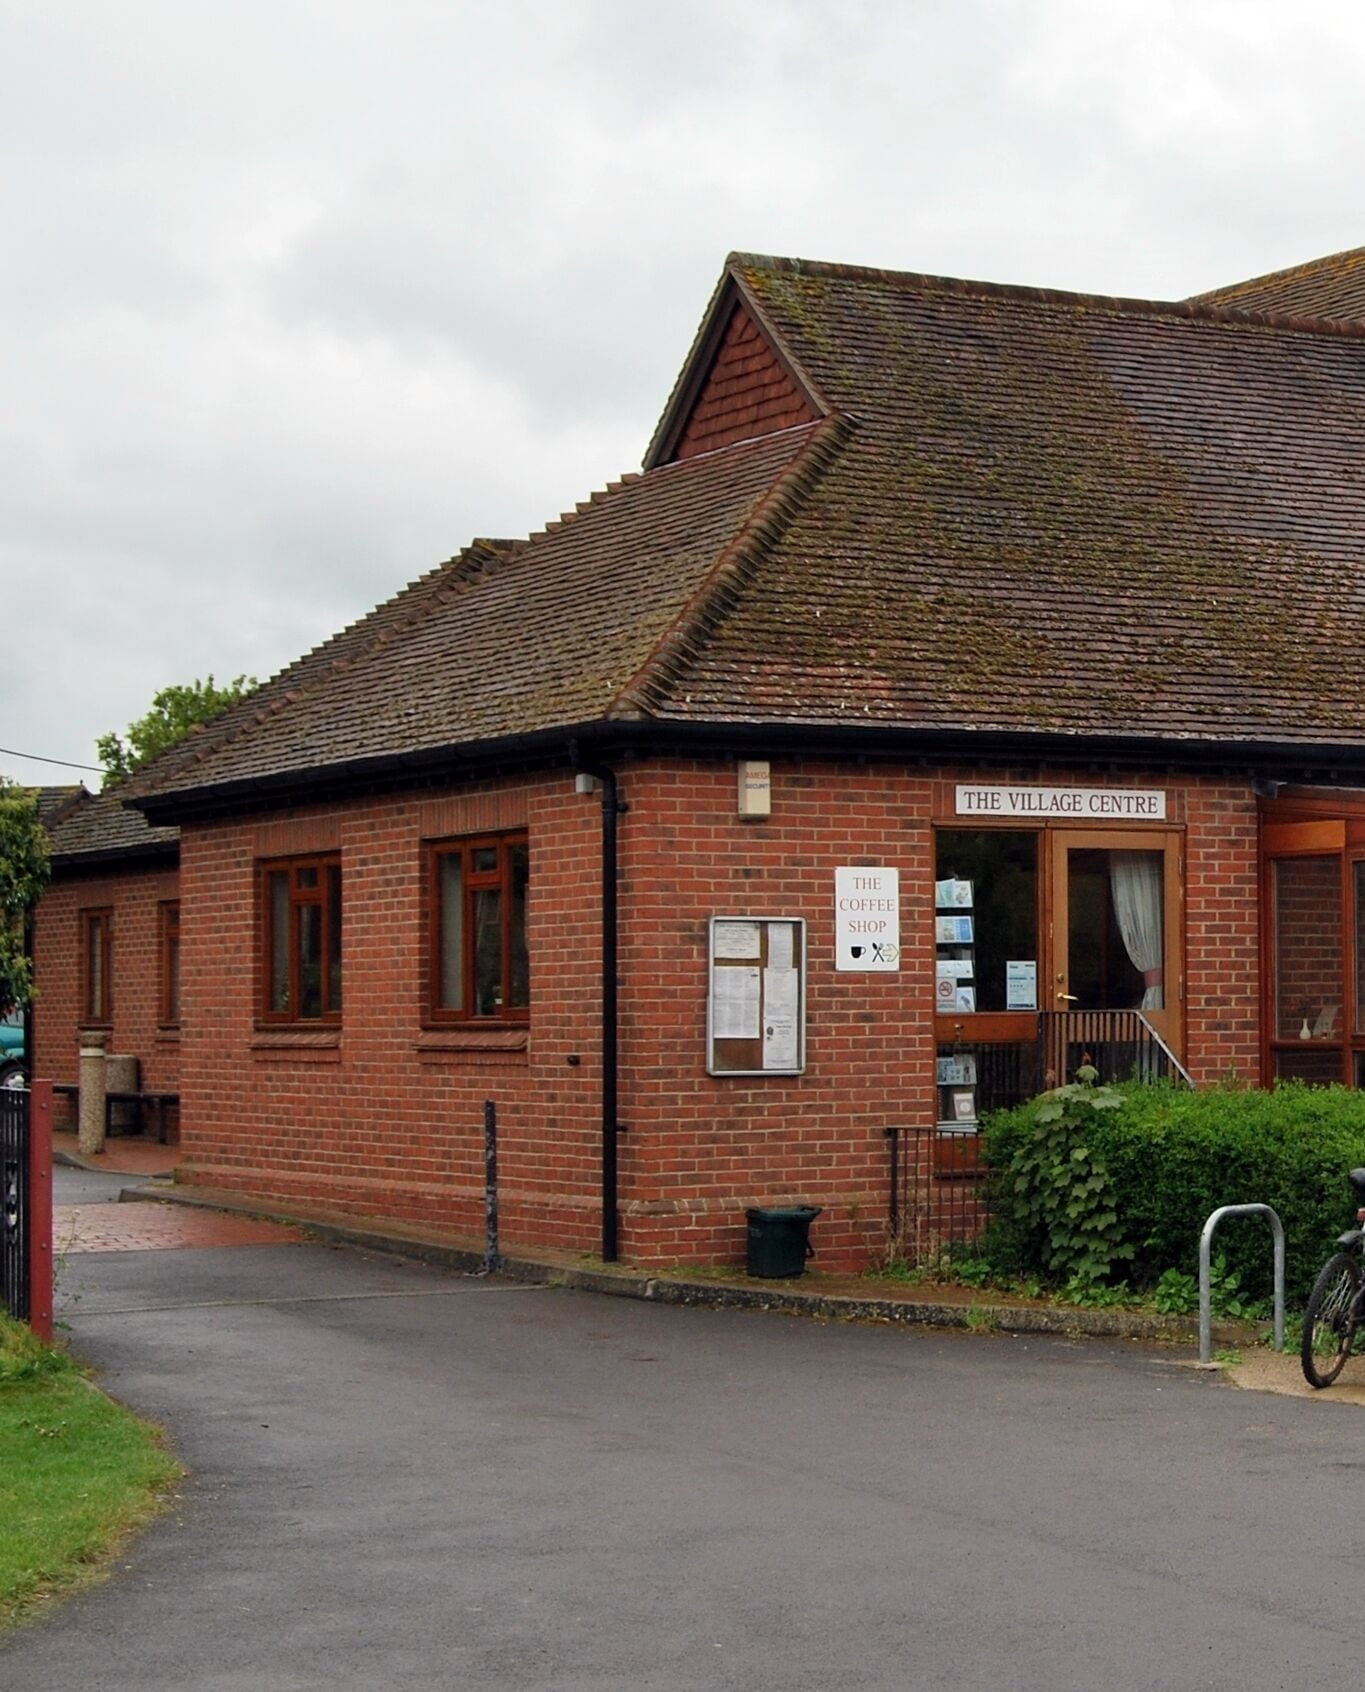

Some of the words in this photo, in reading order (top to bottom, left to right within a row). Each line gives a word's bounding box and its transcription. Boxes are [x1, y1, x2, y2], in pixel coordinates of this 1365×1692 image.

[964, 791, 1001, 809] THE
[1008, 792, 1082, 812] VILLAGE
[1089, 795, 1158, 814] CENTRE
[853, 877, 882, 890] THE
[840, 899, 895, 911] COFFEE
[848, 921, 887, 933] SHOP
